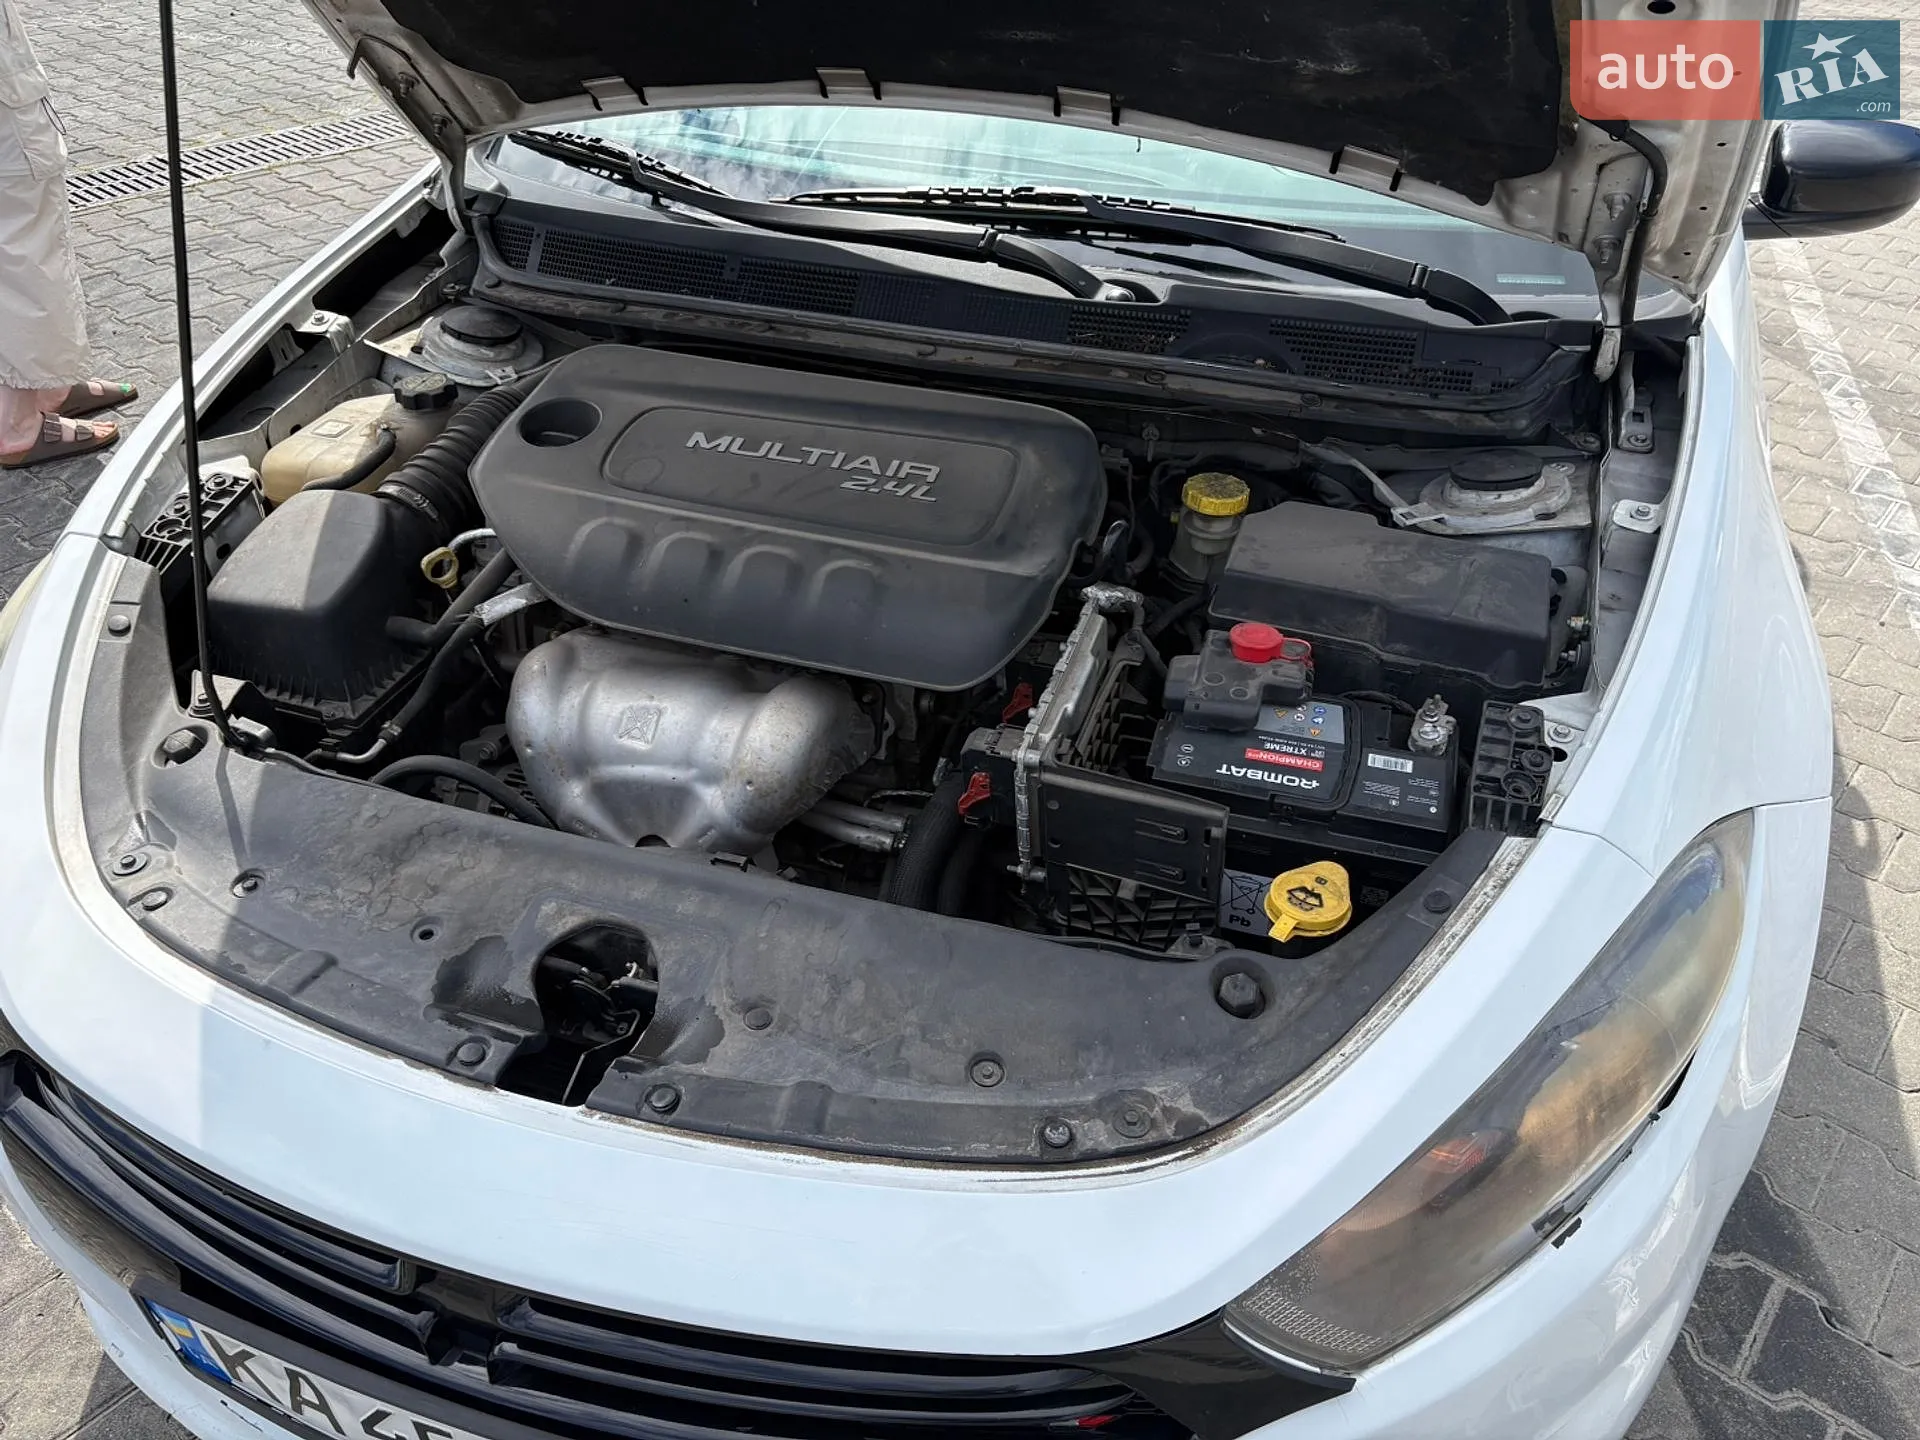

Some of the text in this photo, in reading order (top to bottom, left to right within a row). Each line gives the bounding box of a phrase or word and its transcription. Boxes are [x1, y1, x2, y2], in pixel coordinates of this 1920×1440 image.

[685, 431, 941, 482] MULTIAIR
[839, 475, 937, 502] 2.4L
[1216, 763, 1320, 790] ROMBAT
[1229, 914, 1252, 927] Pb
